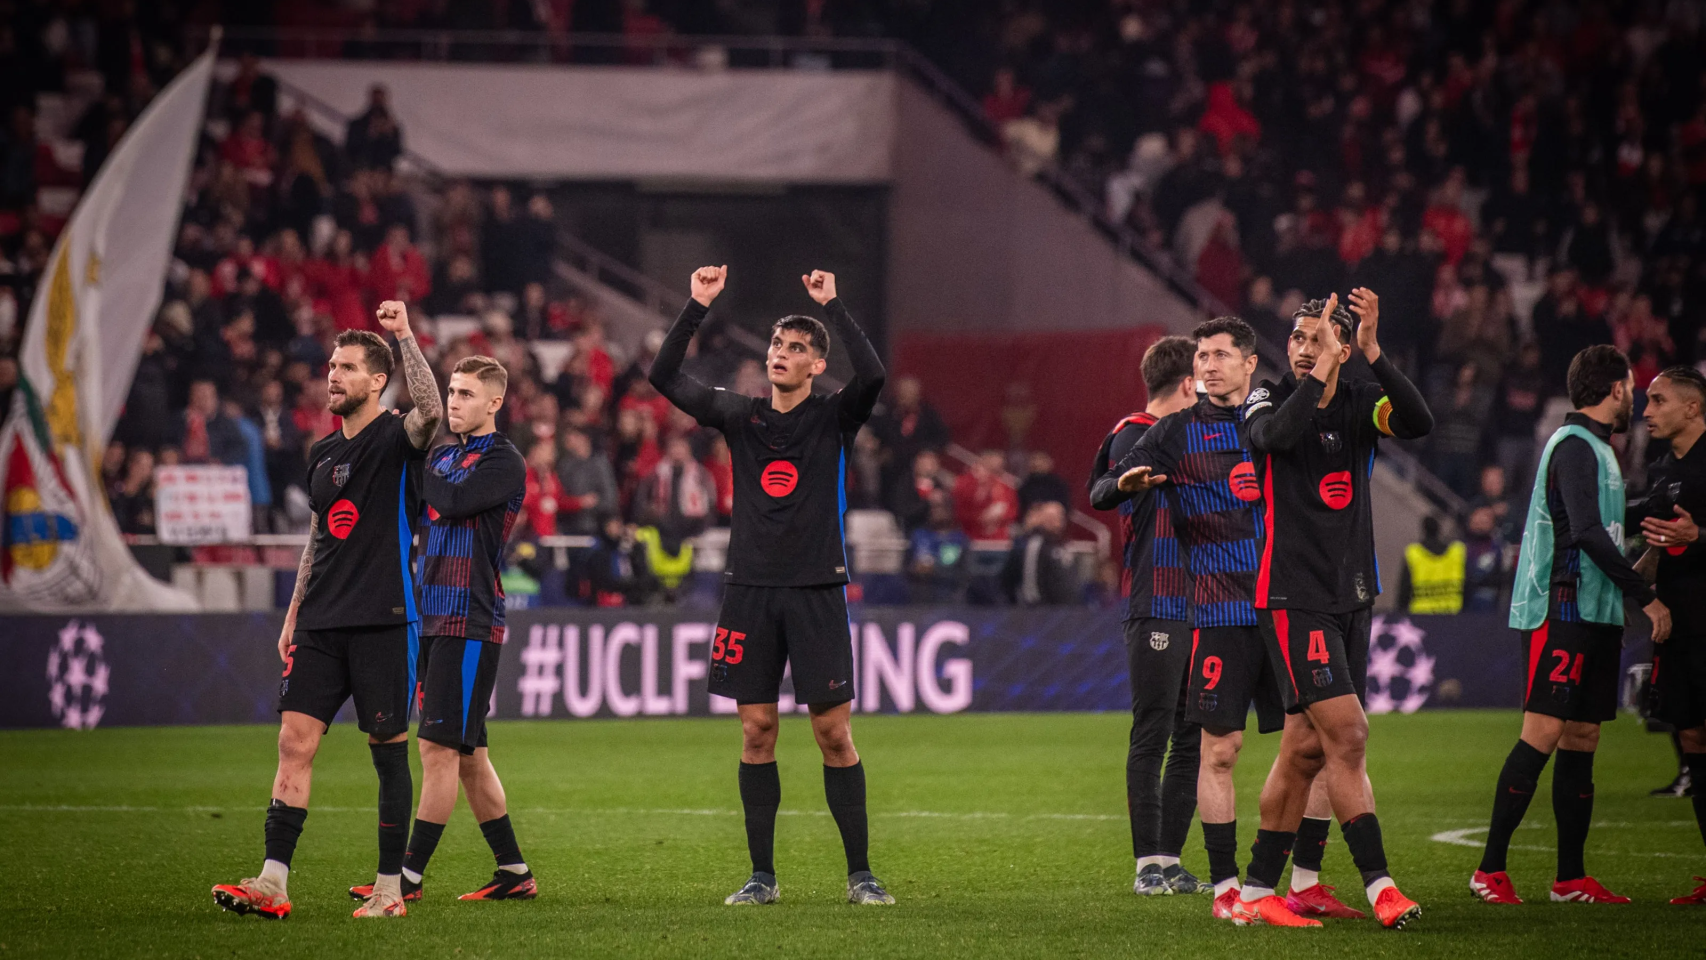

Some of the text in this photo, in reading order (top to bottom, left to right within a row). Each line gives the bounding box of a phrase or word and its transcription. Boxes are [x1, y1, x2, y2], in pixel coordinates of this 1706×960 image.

[712, 627, 747, 664] 35
[1307, 630, 1330, 664] 4
[1202, 655, 1223, 690] 9
[1549, 650, 1584, 685] 24
